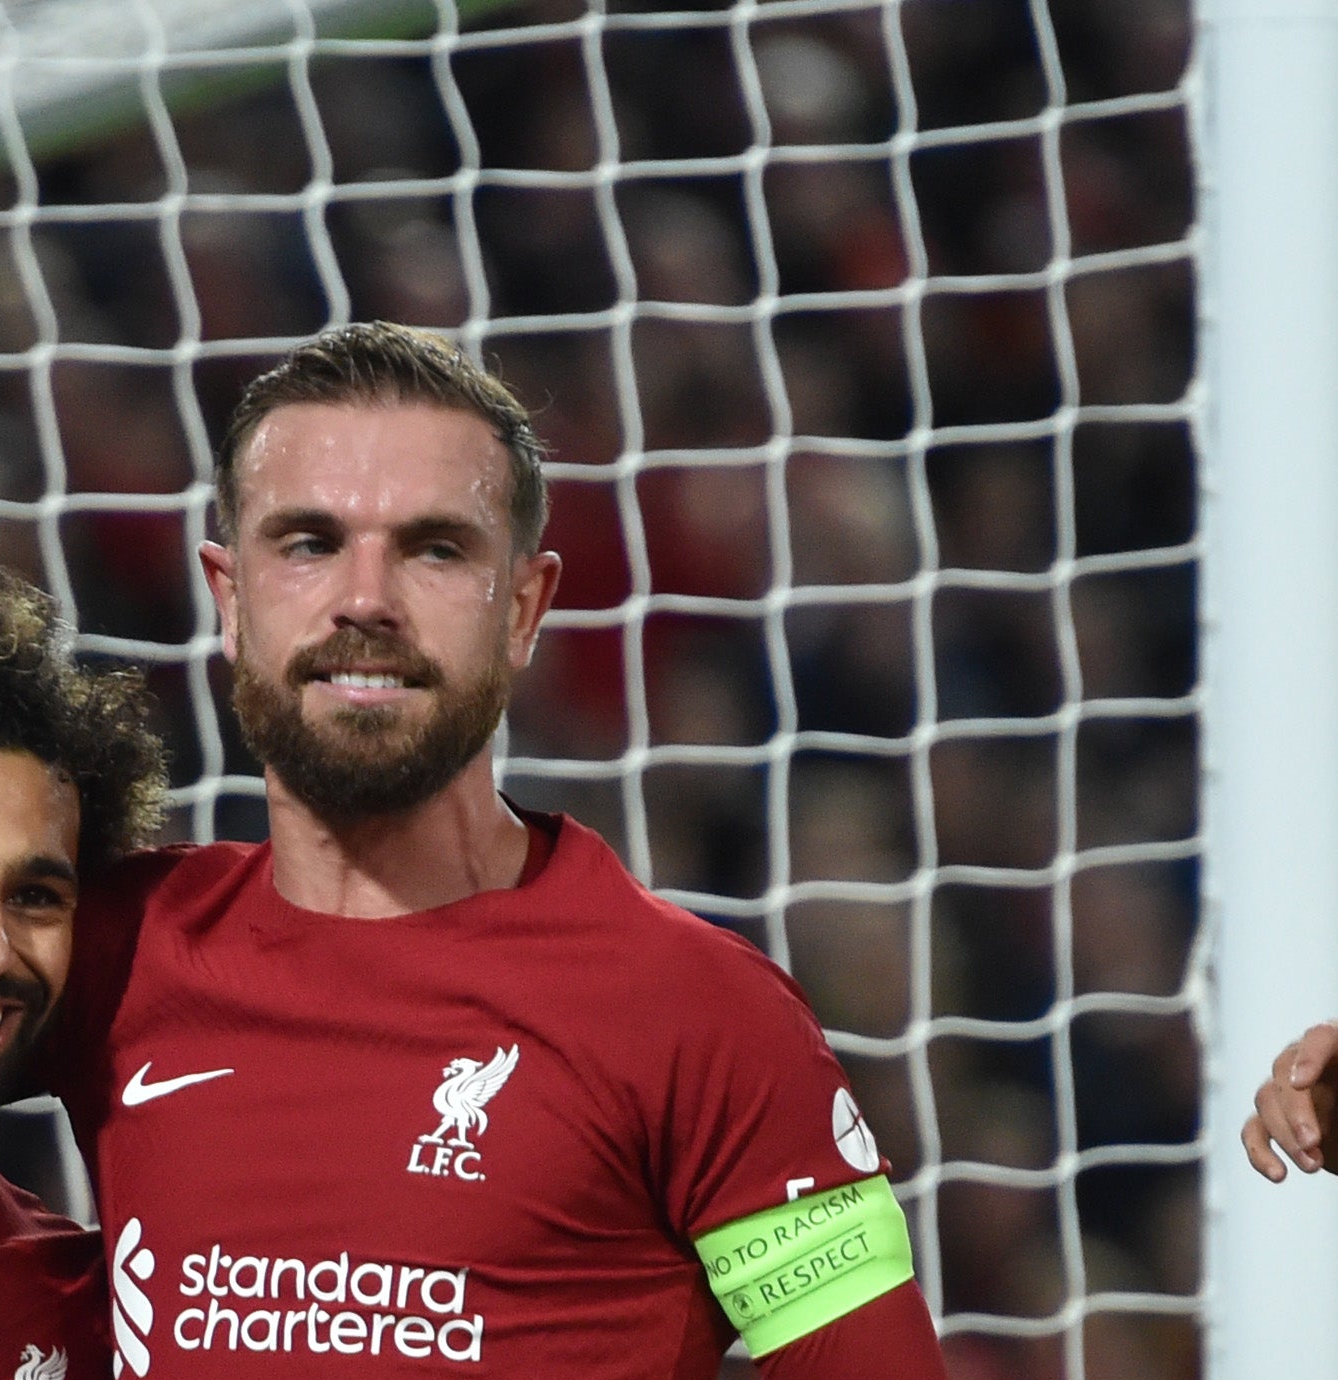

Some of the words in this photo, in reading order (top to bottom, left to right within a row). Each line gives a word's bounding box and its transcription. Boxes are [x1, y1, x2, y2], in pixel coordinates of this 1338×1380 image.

[406, 1144, 486, 1181] L.F.C.
[733, 1238, 769, 1266] TO
[773, 1186, 865, 1246] RACISM
[179, 1244, 470, 1314] standard
[759, 1231, 870, 1305] RESPECT
[174, 1298, 484, 1362] chartered
